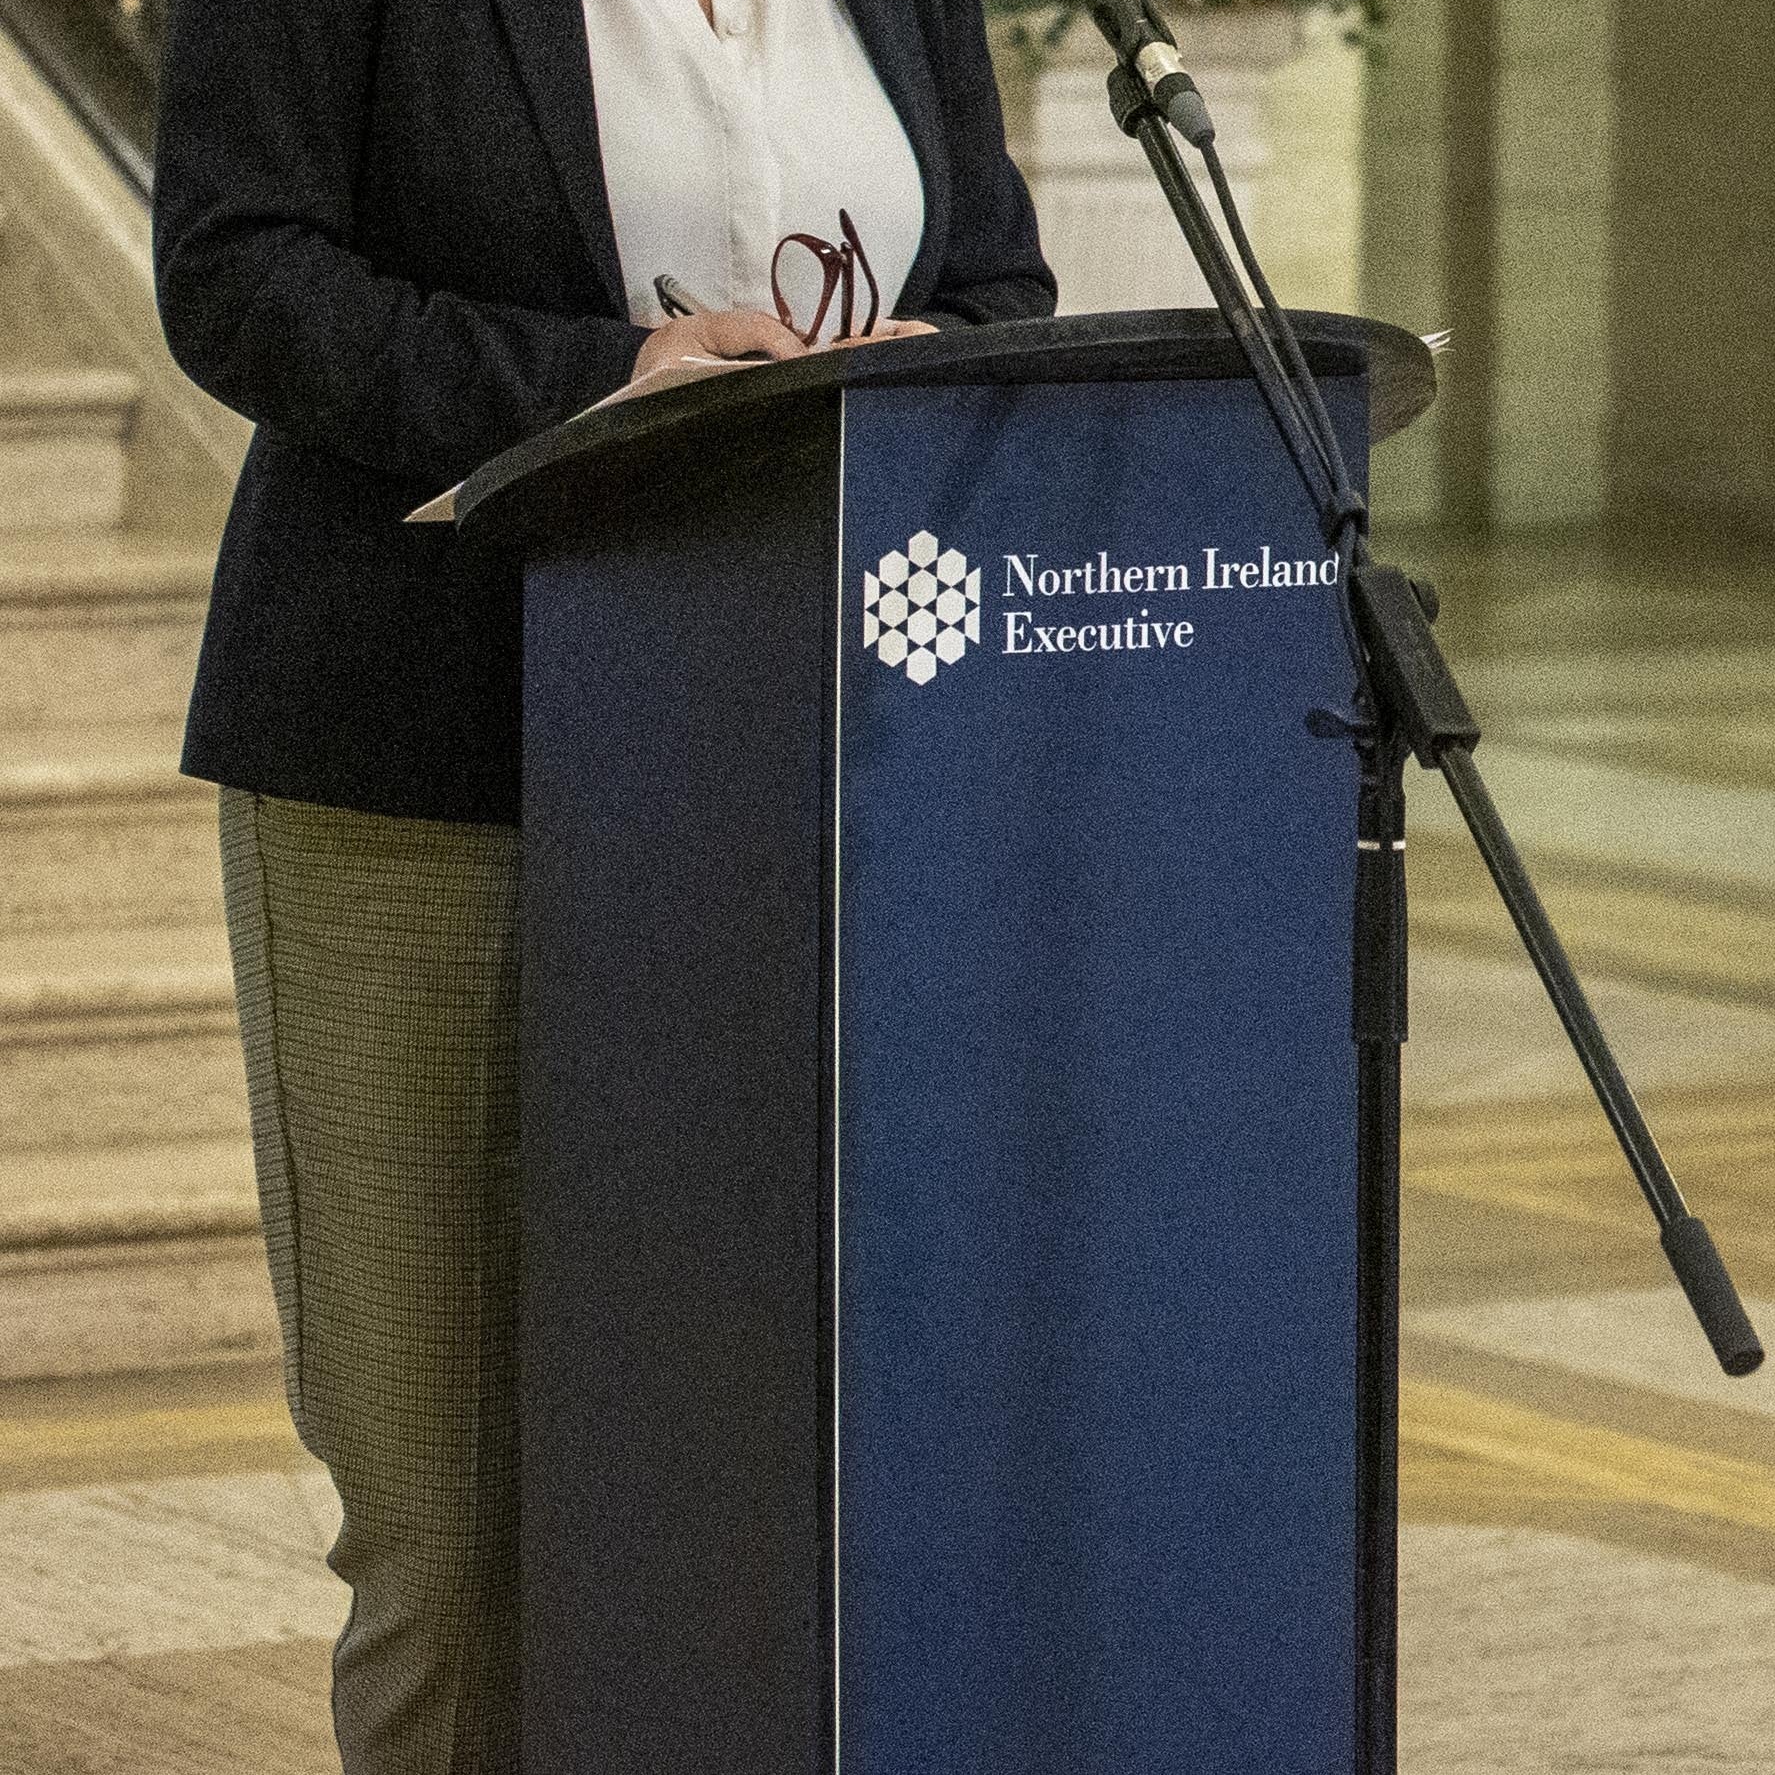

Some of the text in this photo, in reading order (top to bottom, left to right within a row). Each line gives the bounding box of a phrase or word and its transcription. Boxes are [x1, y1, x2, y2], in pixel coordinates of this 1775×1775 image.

[1002, 546, 1339, 598] Northern Ireland
[1001, 608, 1195, 655] Executive
